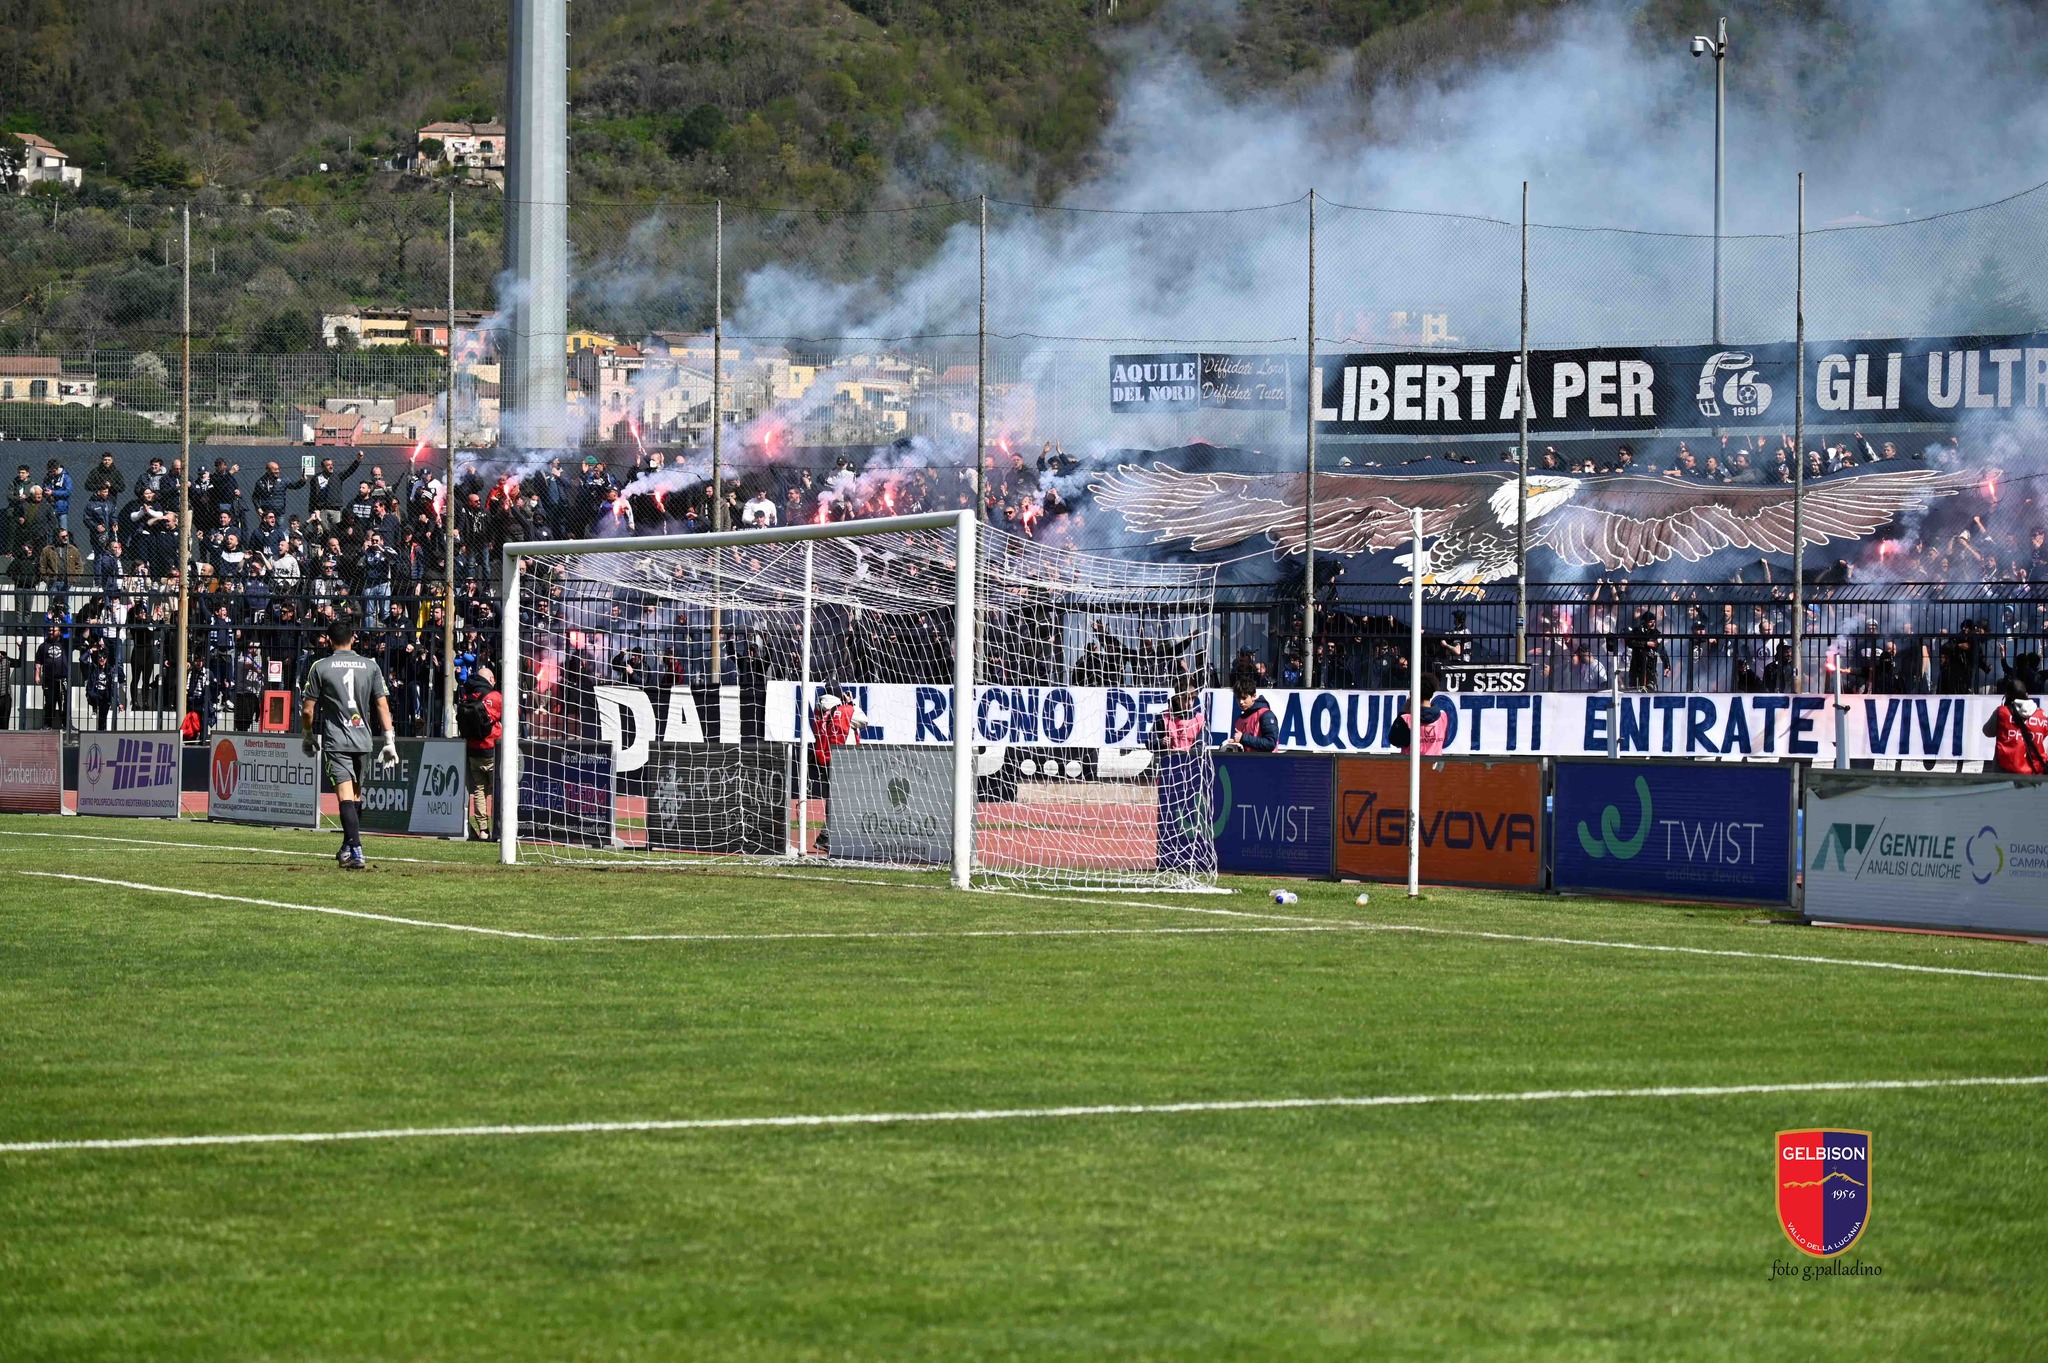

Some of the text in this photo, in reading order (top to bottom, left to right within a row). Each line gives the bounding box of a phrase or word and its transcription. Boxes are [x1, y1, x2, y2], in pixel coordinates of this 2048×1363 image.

[1112, 362, 1196, 383] AQUILE
[1112, 385, 1196, 403] DEL NORD
[1552, 360, 1657, 418] PER
[1816, 352, 1902, 411] GLI
[1732, 406, 1757, 417] 1919
[342, 668, 357, 709] 1
[1473, 672, 1526, 693] SESS
[1583, 696, 1825, 754] ENTRATE
[1864, 698, 1965, 757] VIVI
[243, 739, 286, 749] Alberto Romano
[238, 760, 313, 785] microdata
[360, 787, 408, 811] SCOPRI
[427, 801, 453, 815] NAPOLI
[1237, 804, 1315, 843] TWIST
[1659, 820, 1764, 865] TWIST
[1880, 832, 1956, 859] GENTILE
[1867, 859, 1962, 879] ANALISI CLINICHE
